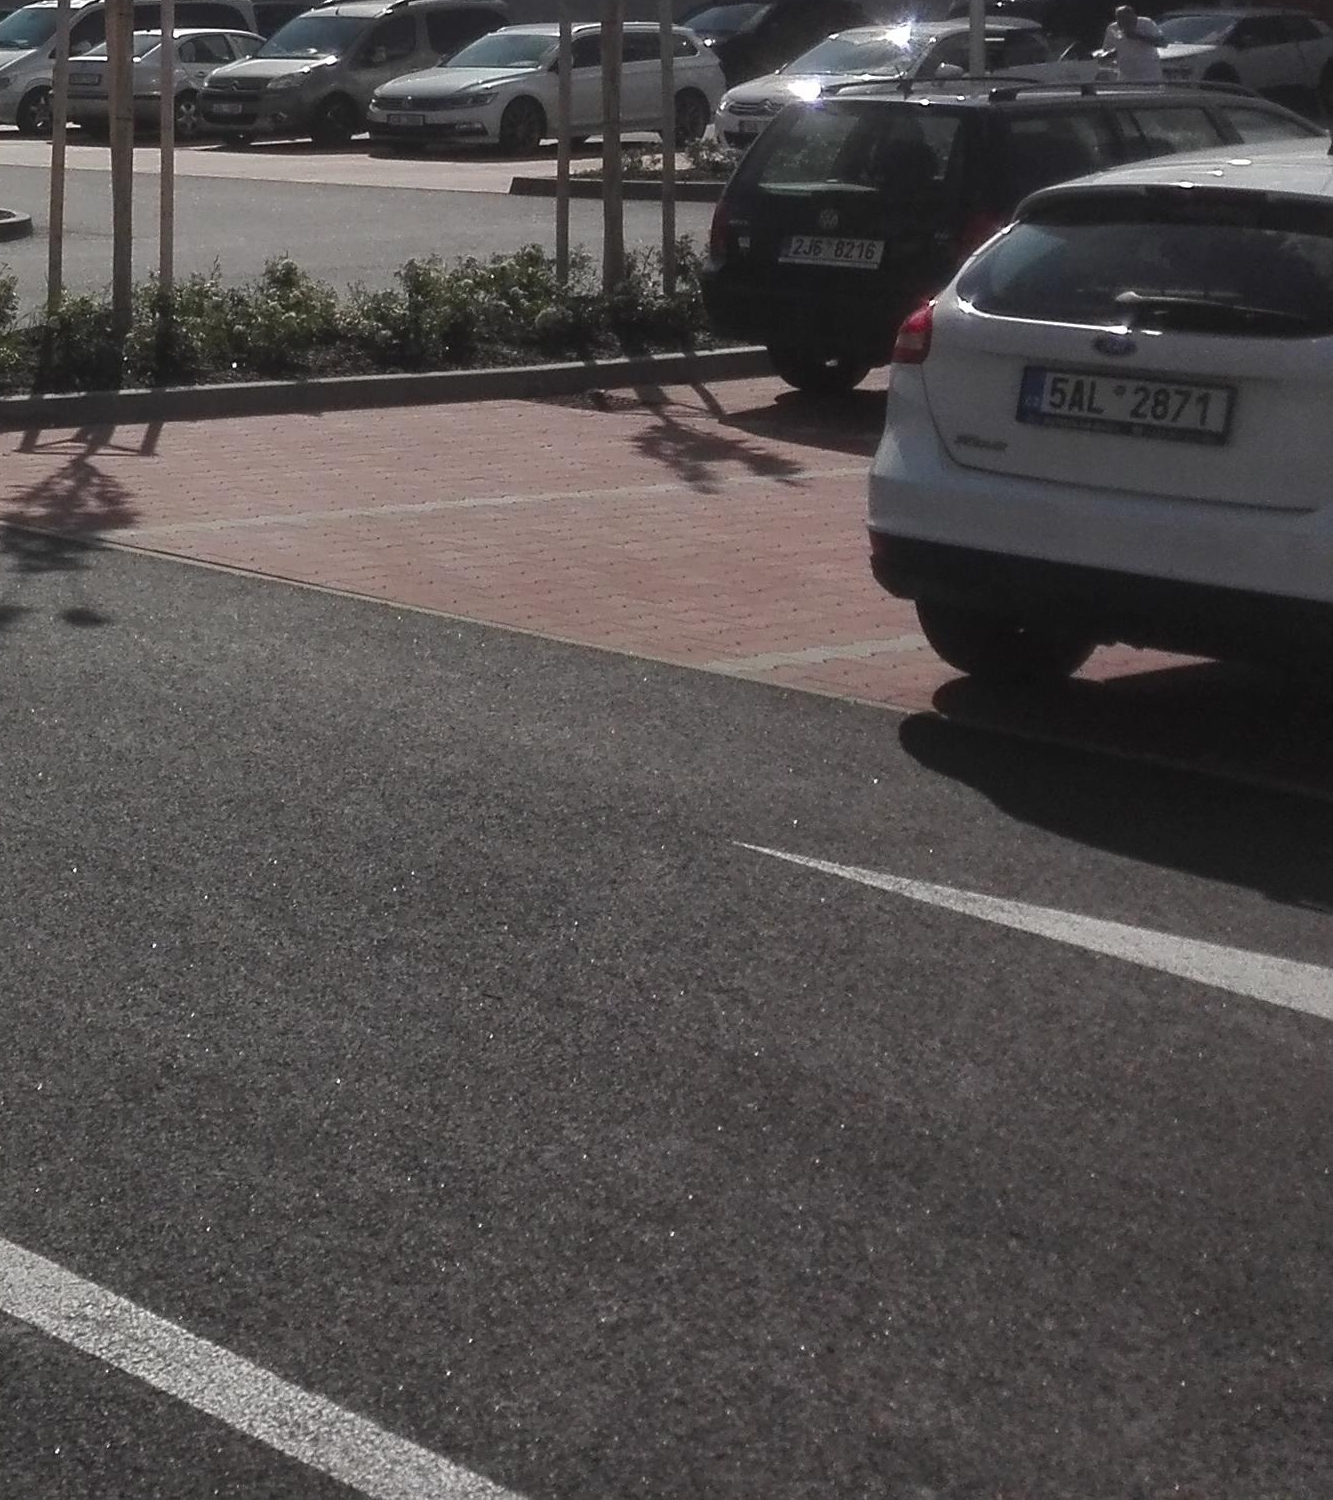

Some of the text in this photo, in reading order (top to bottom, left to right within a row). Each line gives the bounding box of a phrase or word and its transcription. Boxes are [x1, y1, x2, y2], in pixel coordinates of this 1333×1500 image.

[792, 238, 823, 257] 2J6
[1048, 376, 1213, 427] 5AL 2871
